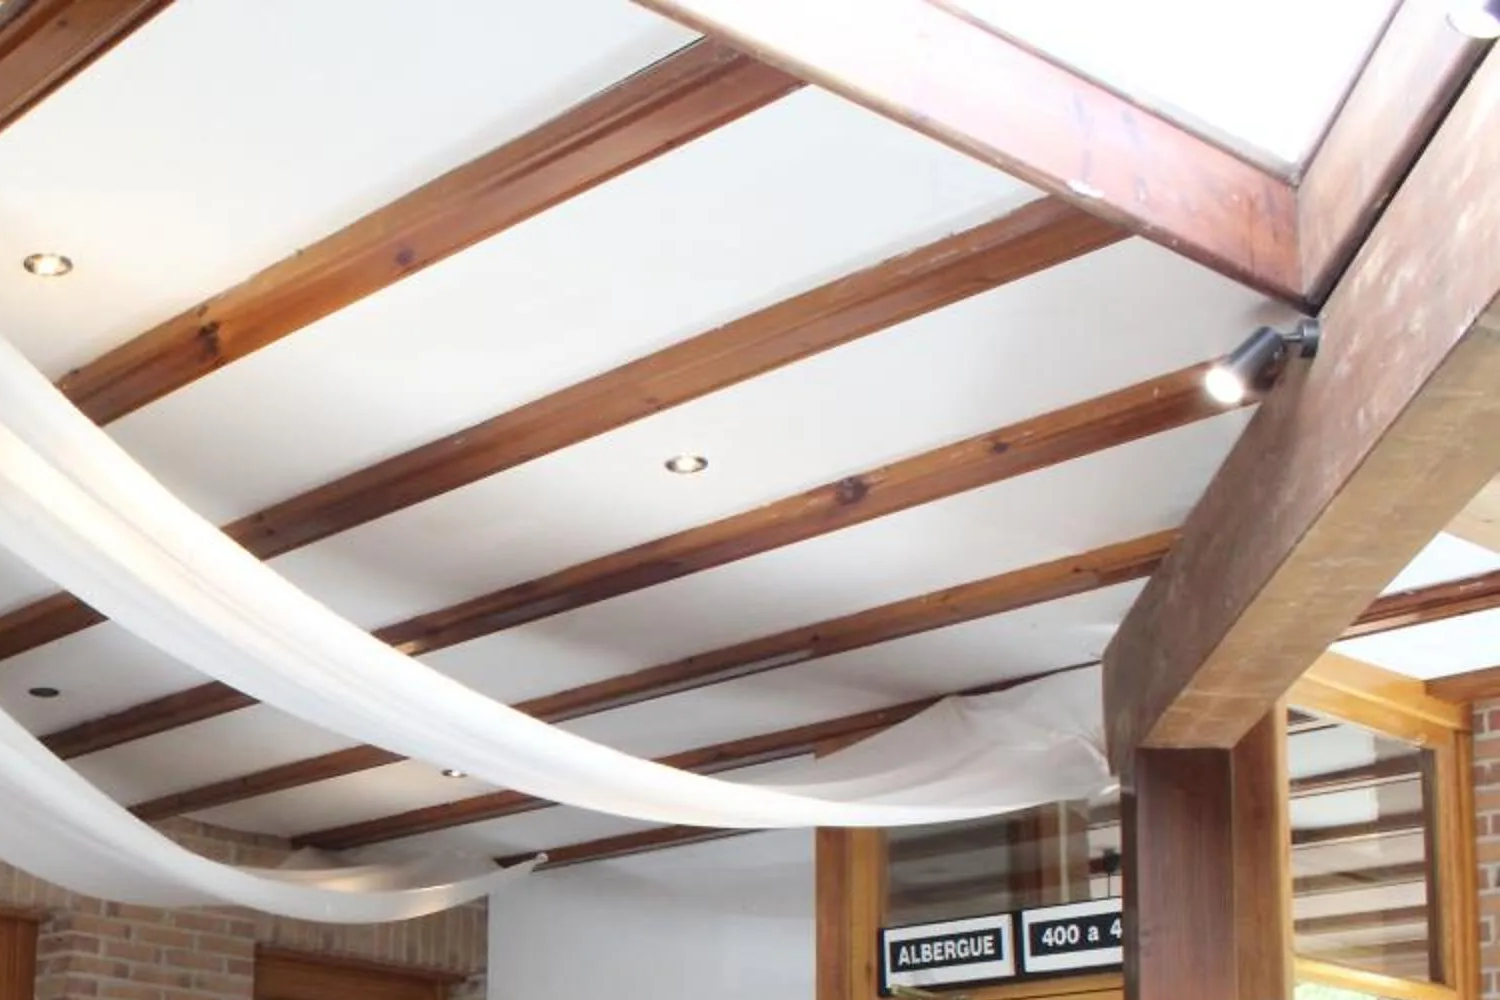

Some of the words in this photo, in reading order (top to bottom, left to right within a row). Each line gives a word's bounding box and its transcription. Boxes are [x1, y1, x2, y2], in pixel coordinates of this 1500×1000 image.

[1041, 924, 1080, 947] 400
[1087, 925, 1099, 942] a
[898, 934, 995, 966] ALBERGUE
